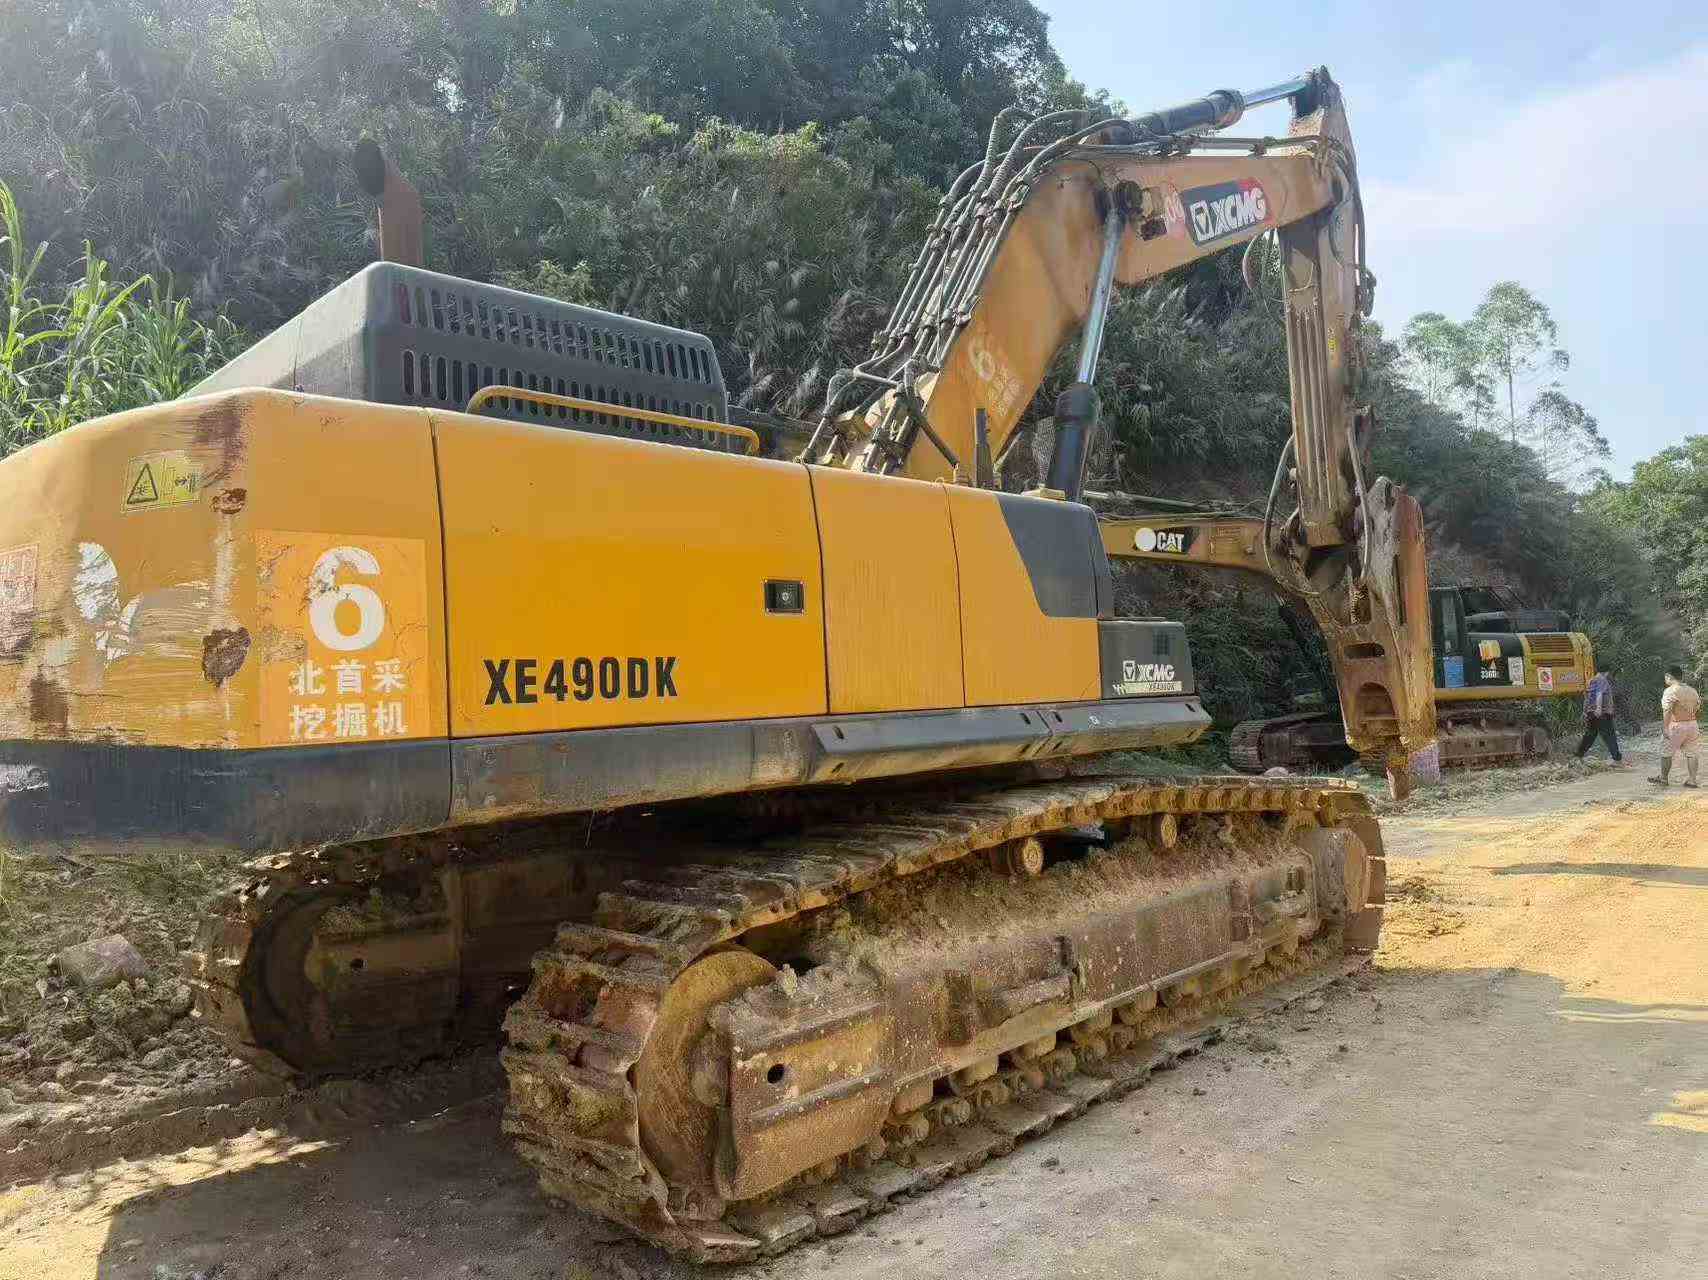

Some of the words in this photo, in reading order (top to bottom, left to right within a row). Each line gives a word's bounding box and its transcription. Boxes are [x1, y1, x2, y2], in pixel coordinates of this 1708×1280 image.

[1210, 187, 1266, 236] XCMG
[1156, 531, 1185, 553] CAT
[308, 546, 385, 652] 6
[288, 659, 409, 697] 北首采
[483, 655, 678, 704] XE490DK
[1136, 664, 1175, 681] XCMG
[288, 700, 409, 743] 挖掘机
